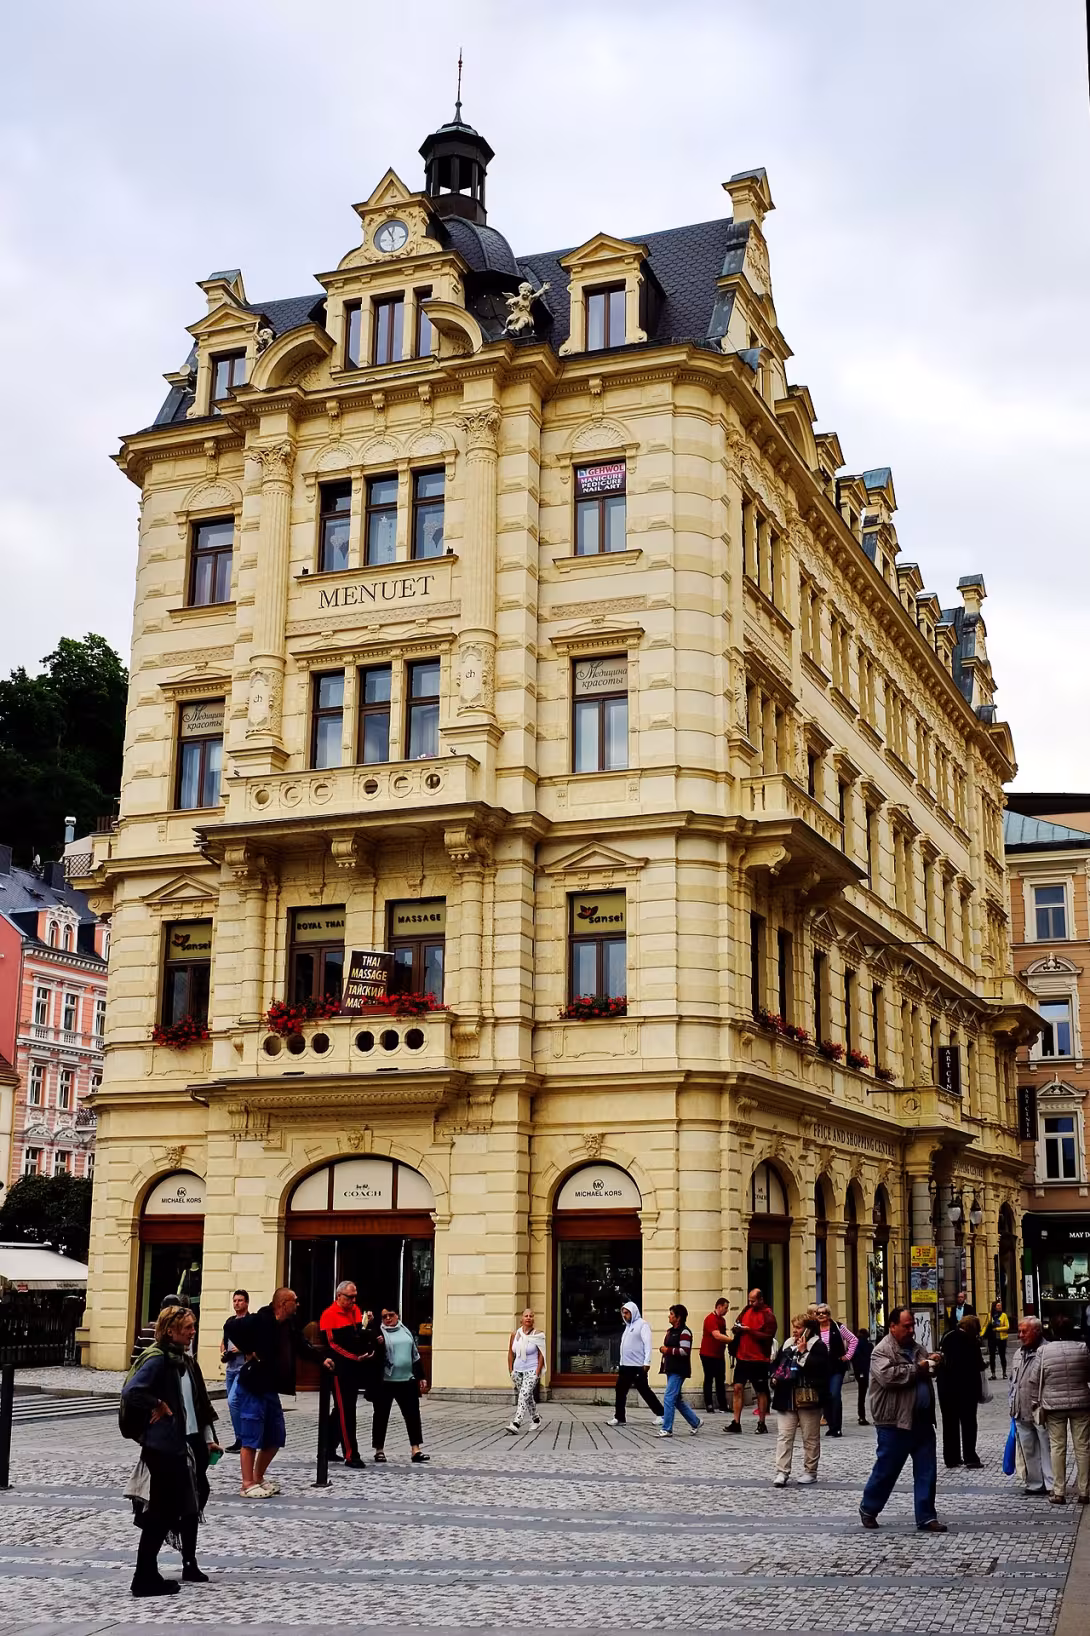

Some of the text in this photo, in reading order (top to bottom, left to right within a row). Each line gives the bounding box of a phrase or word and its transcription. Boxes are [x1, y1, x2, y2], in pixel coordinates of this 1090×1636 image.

[588, 465, 624, 475] GEHWOL
[581, 473, 623, 483] MANICURE
[582, 479, 622, 488] PEDICURE
[318, 575, 435, 609] MENUET
[581, 677, 624, 689] красоты
[397, 913, 441, 923] MASSAGE
[296, 920, 345, 930] ROYAL THAI
[362, 955, 381, 967] THAI
[351, 967, 388, 981] MASSAGE
[348, 983, 384, 998] ТАЙСКИЙ
[832, 1127, 846, 1143] AND
[846, 1131, 875, 1152] SHOPPING
